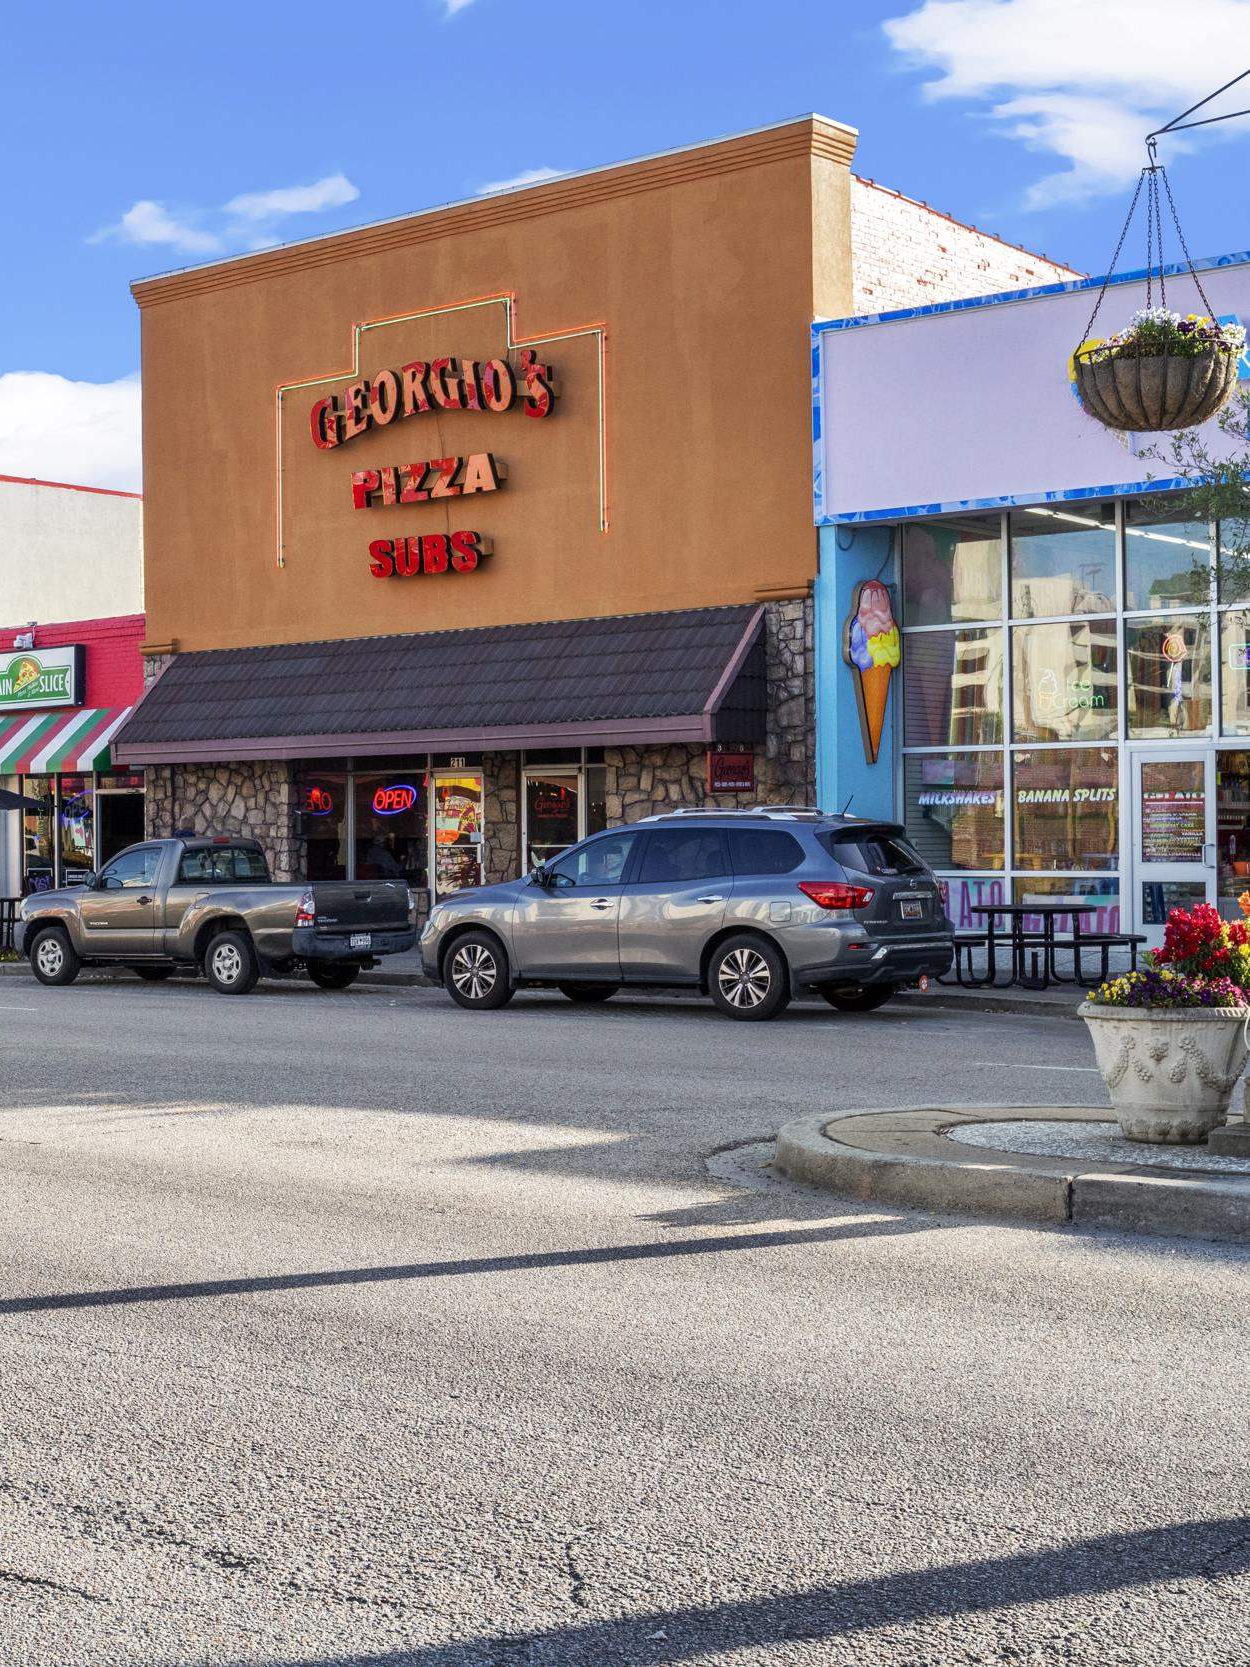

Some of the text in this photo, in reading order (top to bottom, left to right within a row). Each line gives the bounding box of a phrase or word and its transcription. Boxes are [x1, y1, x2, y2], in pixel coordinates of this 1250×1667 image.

[310, 350, 554, 449] GEORGIO'S
[351, 452, 500, 510] PIZZA
[368, 531, 483, 578] SUBS
[39, 674, 64, 692] SLICE
[450, 758, 465, 768] 211
[374, 789, 412, 811] OPEN
[919, 791, 996, 805] MILKSHAKES
[1017, 788, 1117, 803] BANANA SPLITS
